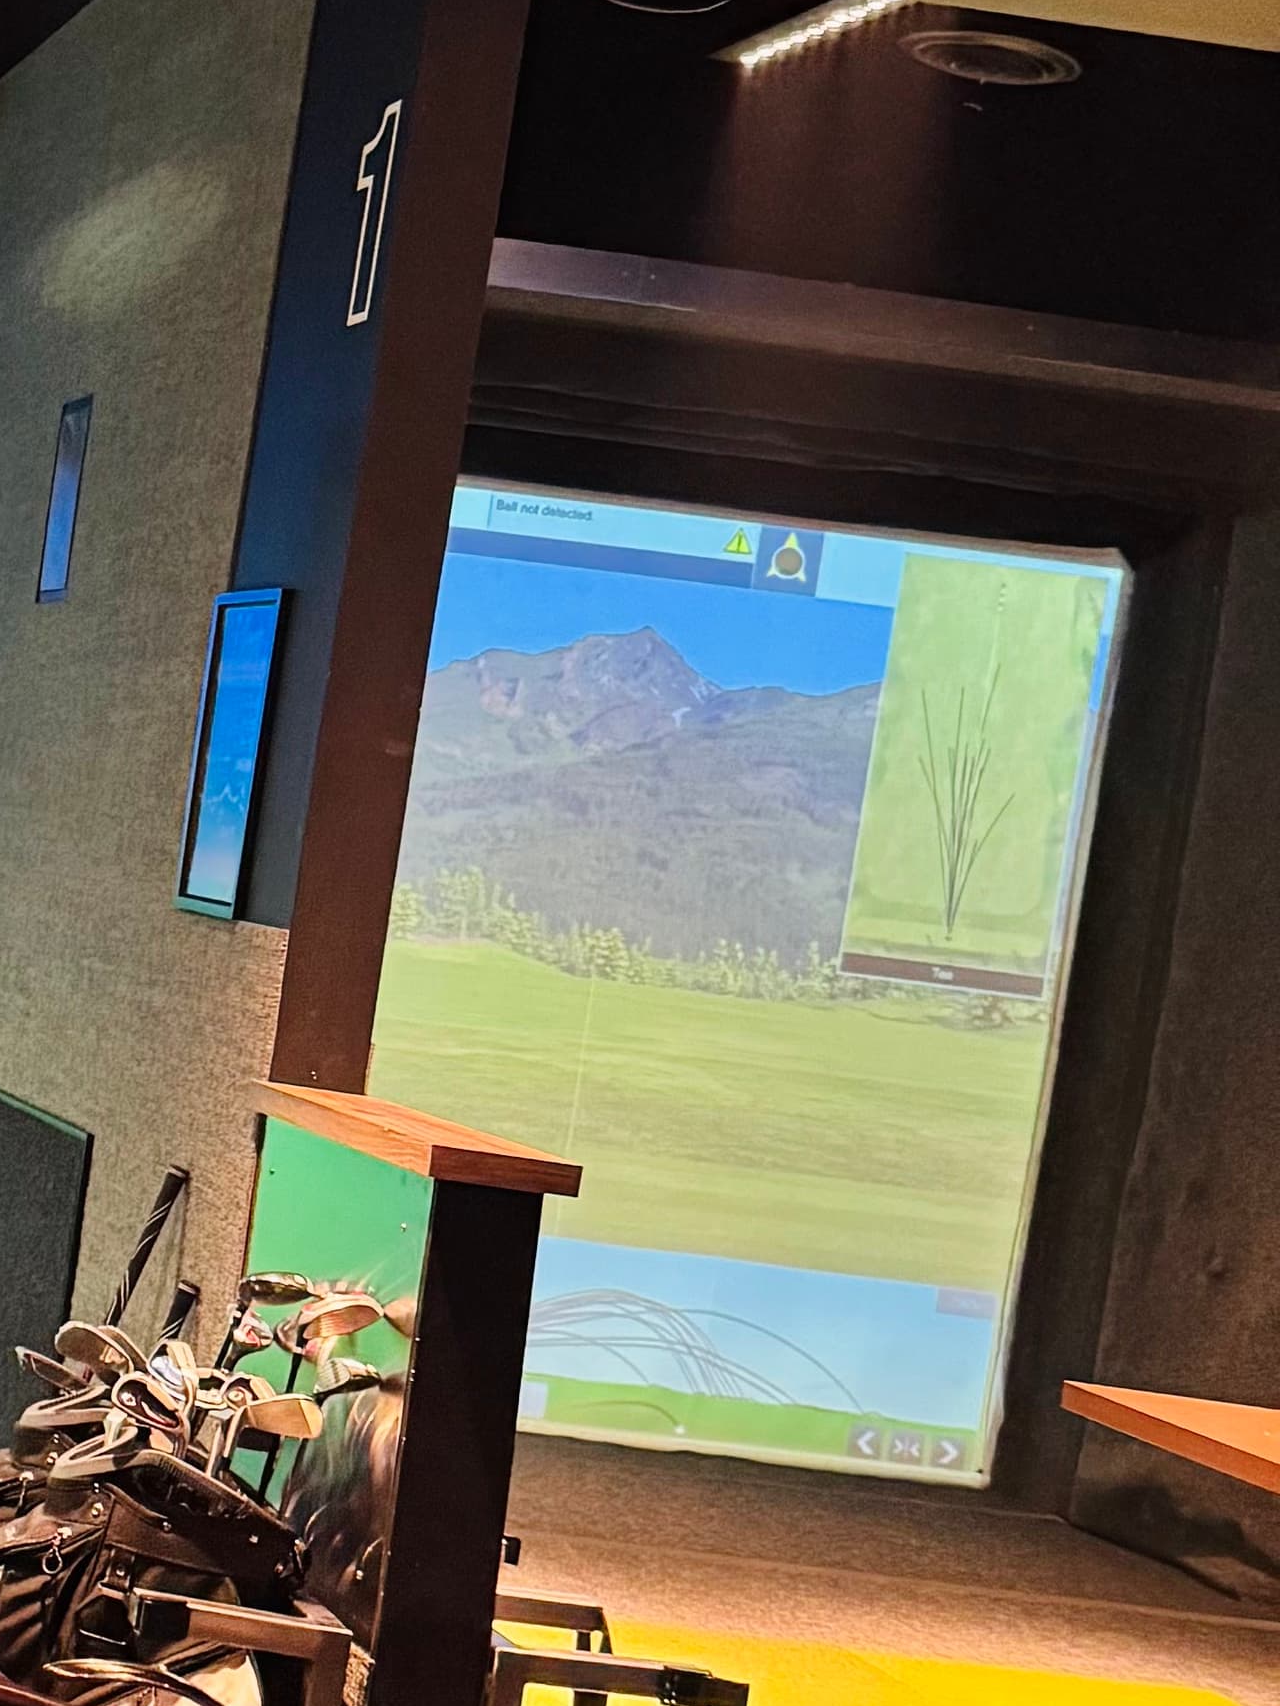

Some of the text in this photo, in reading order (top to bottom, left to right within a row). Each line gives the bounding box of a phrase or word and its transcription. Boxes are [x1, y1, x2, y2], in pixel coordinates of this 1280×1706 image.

[345, 99, 402, 328] 1
[495, 498, 518, 514] Ball
[520, 502, 539, 515] not
